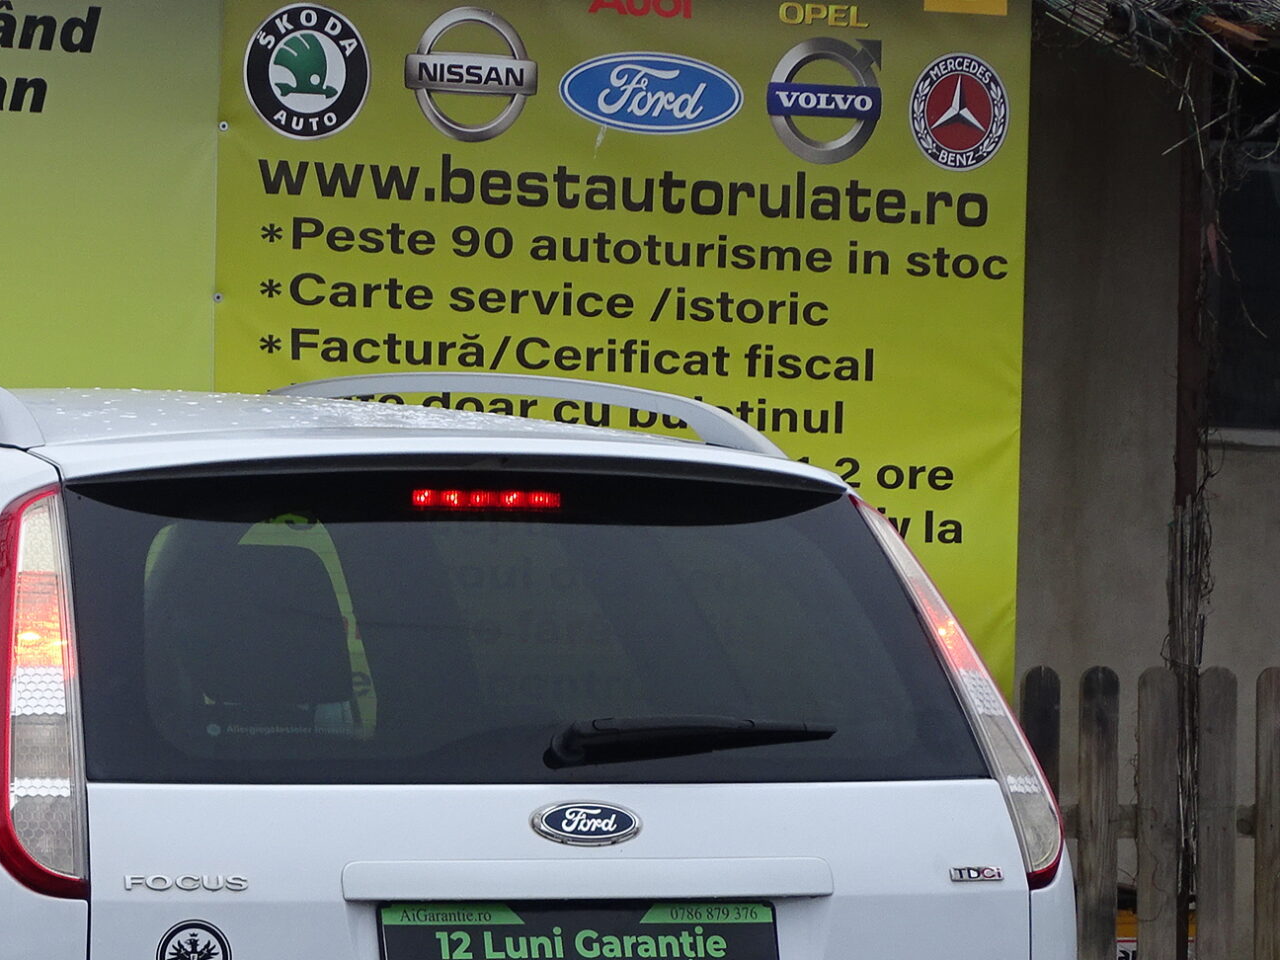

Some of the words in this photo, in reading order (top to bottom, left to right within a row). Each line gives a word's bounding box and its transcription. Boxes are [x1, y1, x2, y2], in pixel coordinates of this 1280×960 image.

[779, 2, 870, 28] OPEL
[418, 62, 524, 87] NISSAN
[929, 58, 993, 84] MERCEDES
[597, 64, 707, 120] Ford
[776, 91, 873, 111] VOLVO
[273, 109, 337, 131] AUTO
[938, 151, 977, 167] BENZ
[259, 153, 988, 227] www.bestautorulate.ro
[451, 225, 513, 259] 90
[529, 232, 833, 273] autoturisme
[848, 241, 890, 275] in
[906, 247, 1009, 280] stoc
[449, 282, 634, 319] service
[744, 344, 874, 382] fiscal
[553, 399, 610, 428] cu
[629, 396, 844, 434] butinul
[876, 463, 954, 491] ore
[925, 510, 962, 544] la
[561, 808, 618, 832] Ford
[124, 874, 249, 892] FOCUS
[953, 867, 1002, 879] TDCi
[400, 908, 492, 922] AiGarantie.ro
[670, 907, 702, 921] 0786
[706, 907, 730, 921] 879
[734, 907, 758, 920] 376
[435, 931, 473, 960] 12
[483, 926, 564, 959] Luni
